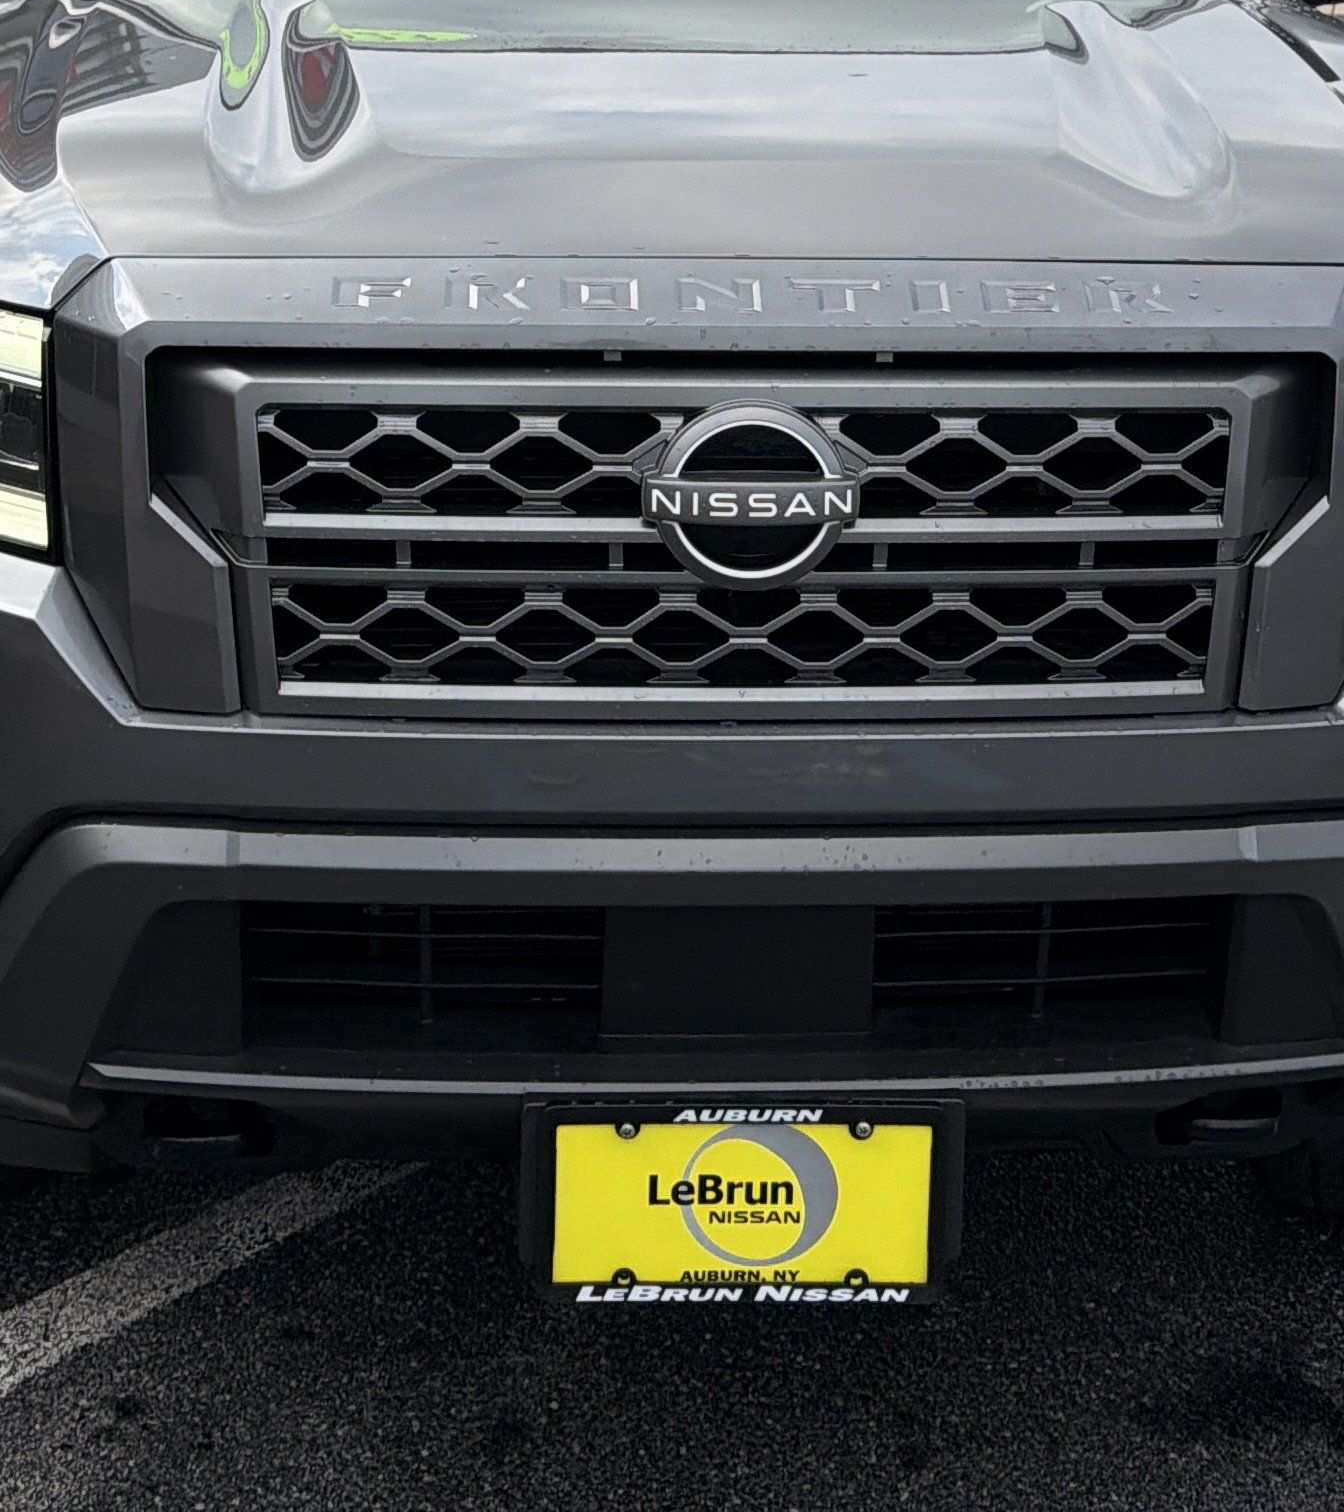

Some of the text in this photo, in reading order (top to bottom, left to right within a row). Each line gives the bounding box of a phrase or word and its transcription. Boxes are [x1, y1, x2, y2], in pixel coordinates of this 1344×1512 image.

[331, 275, 1172, 314] FRONTIER
[651, 488, 853, 518] NISSAN
[673, 1108, 823, 1123] AUBURN
[648, 1174, 794, 1206] LeBrun
[708, 1210, 801, 1225] NISSAN
[680, 1269, 800, 1284] AUBURN, NY
